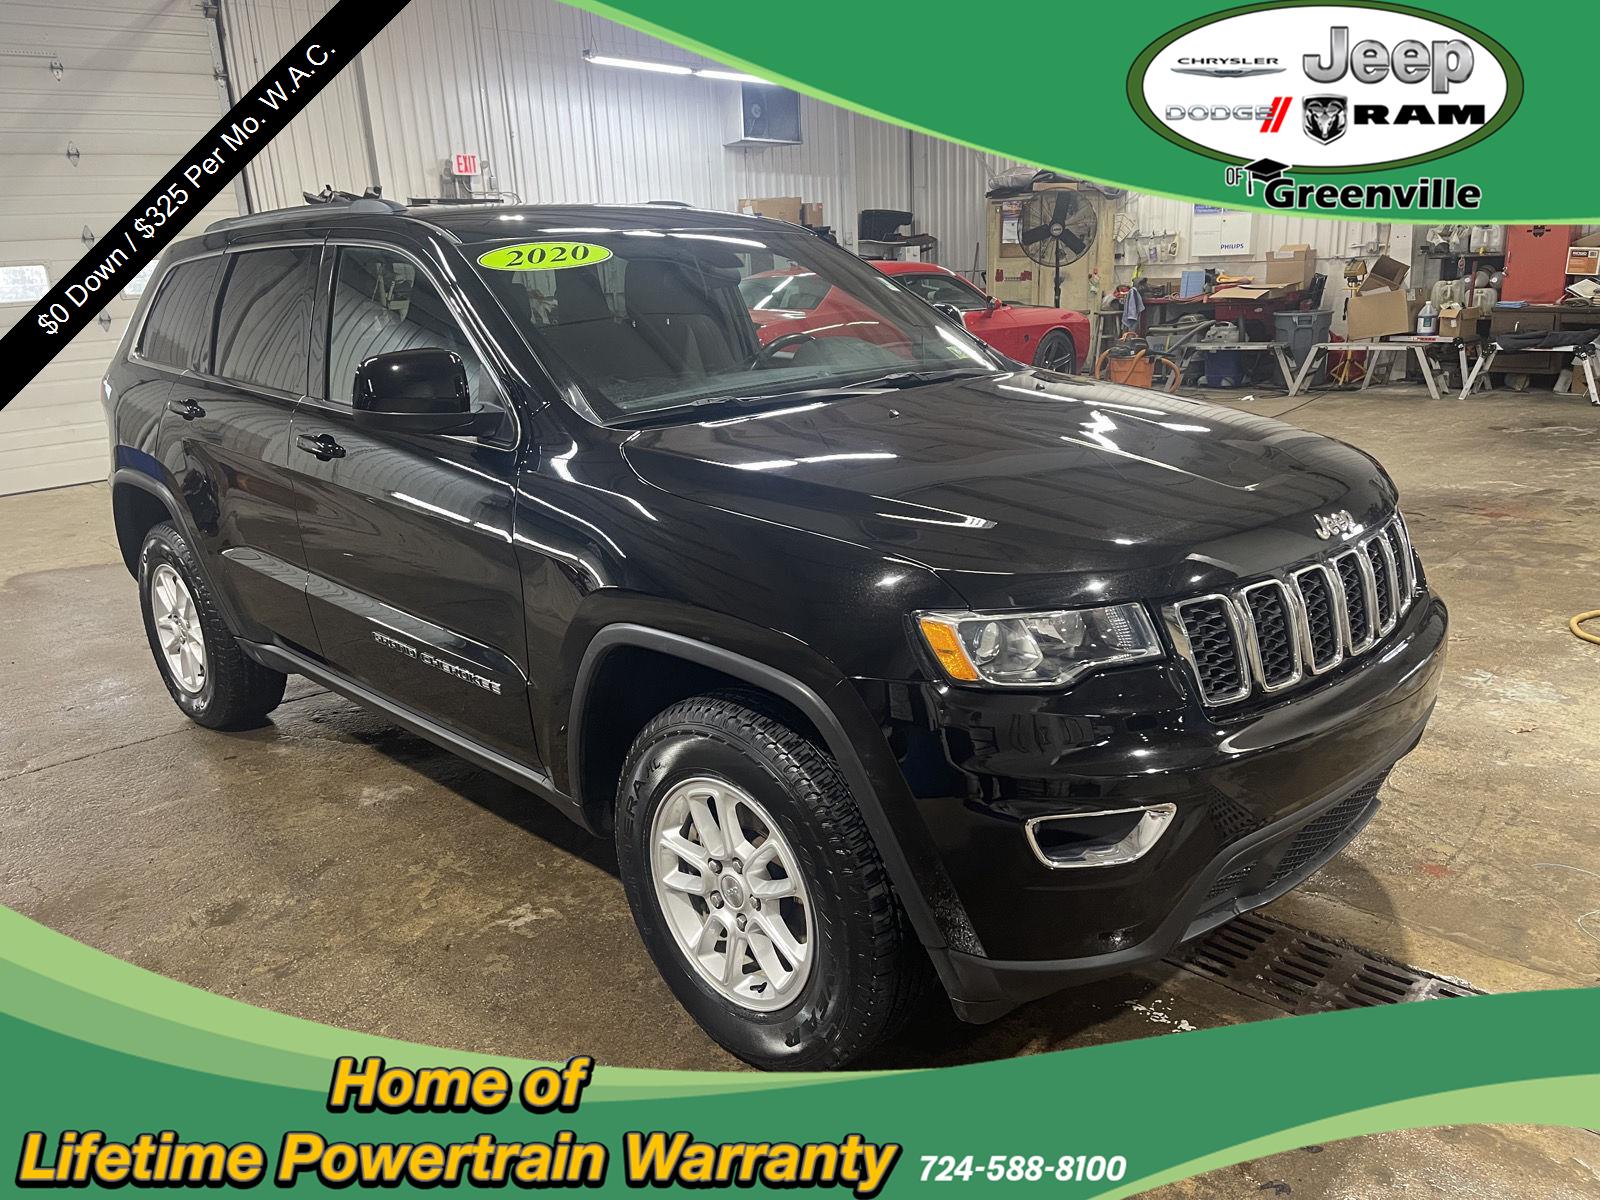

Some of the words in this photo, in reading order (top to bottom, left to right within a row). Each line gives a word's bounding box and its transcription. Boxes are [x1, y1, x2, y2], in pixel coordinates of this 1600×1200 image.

[456, 155, 477, 174] EXIT
[506, 244, 590, 268] 2020
[1313, 509, 1356, 540] Jeep
